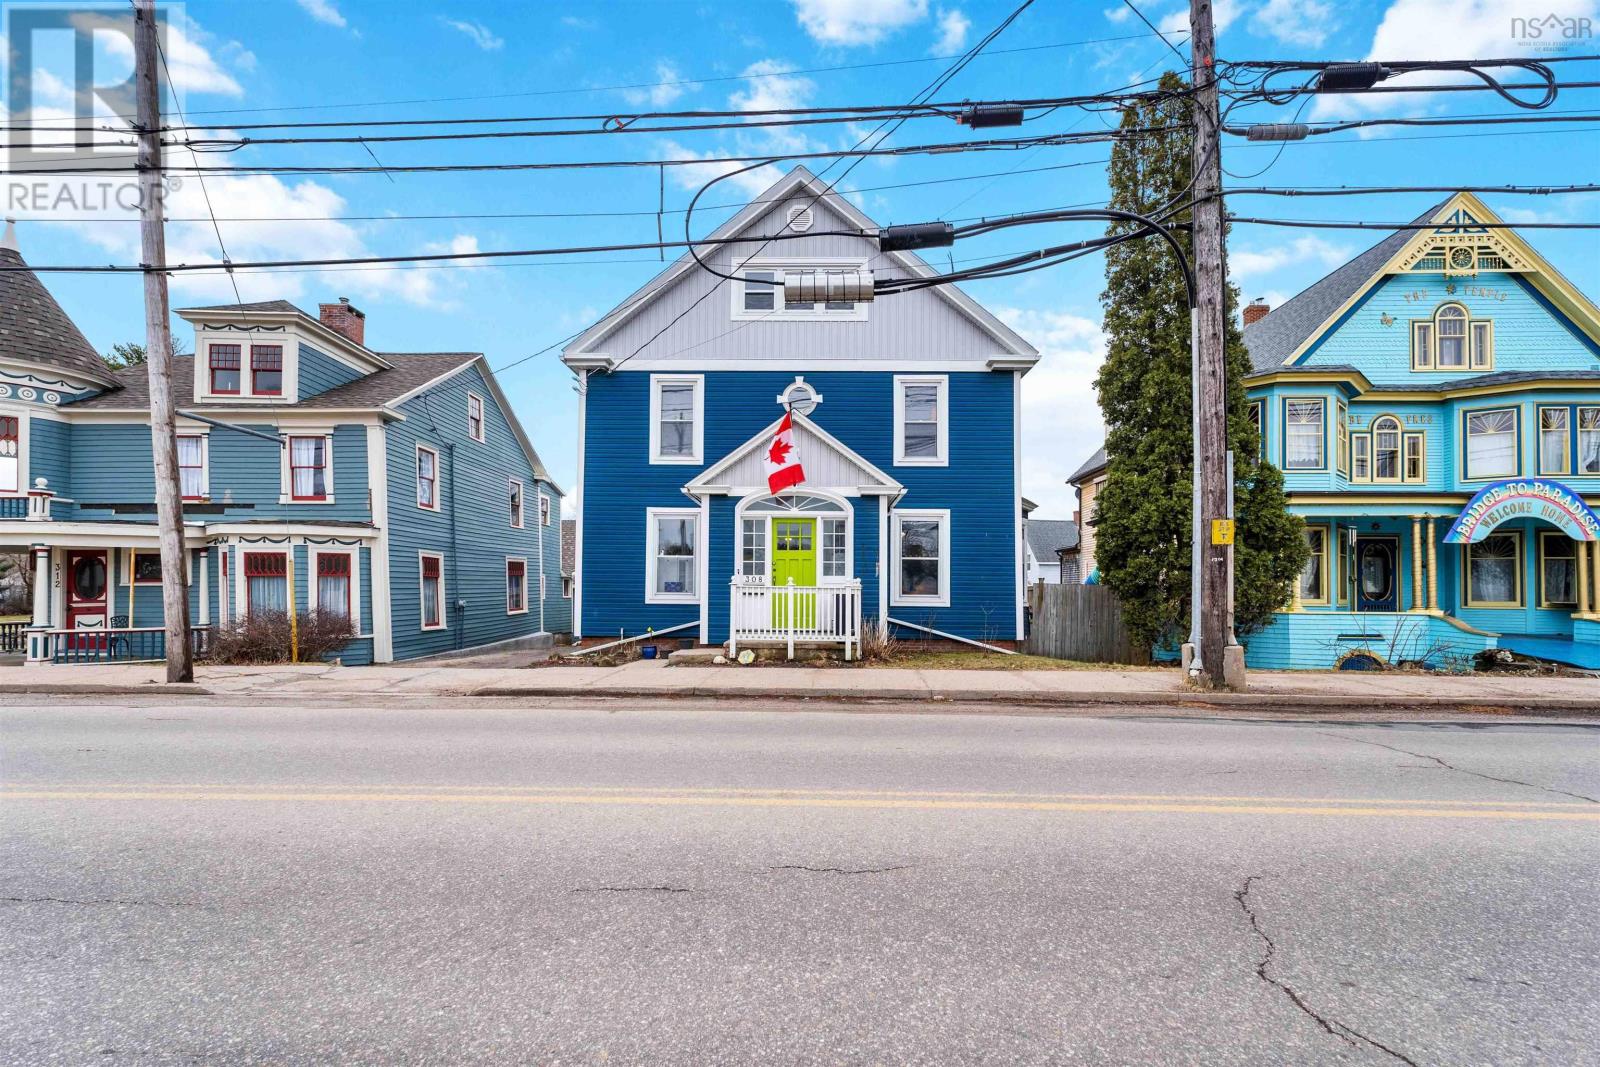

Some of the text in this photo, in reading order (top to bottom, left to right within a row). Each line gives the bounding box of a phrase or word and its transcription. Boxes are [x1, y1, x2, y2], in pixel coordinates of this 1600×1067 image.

[1457, 482, 1599, 537] BRIDGE TO PARADISE
[1480, 501, 1574, 529] WELCOME HOME
